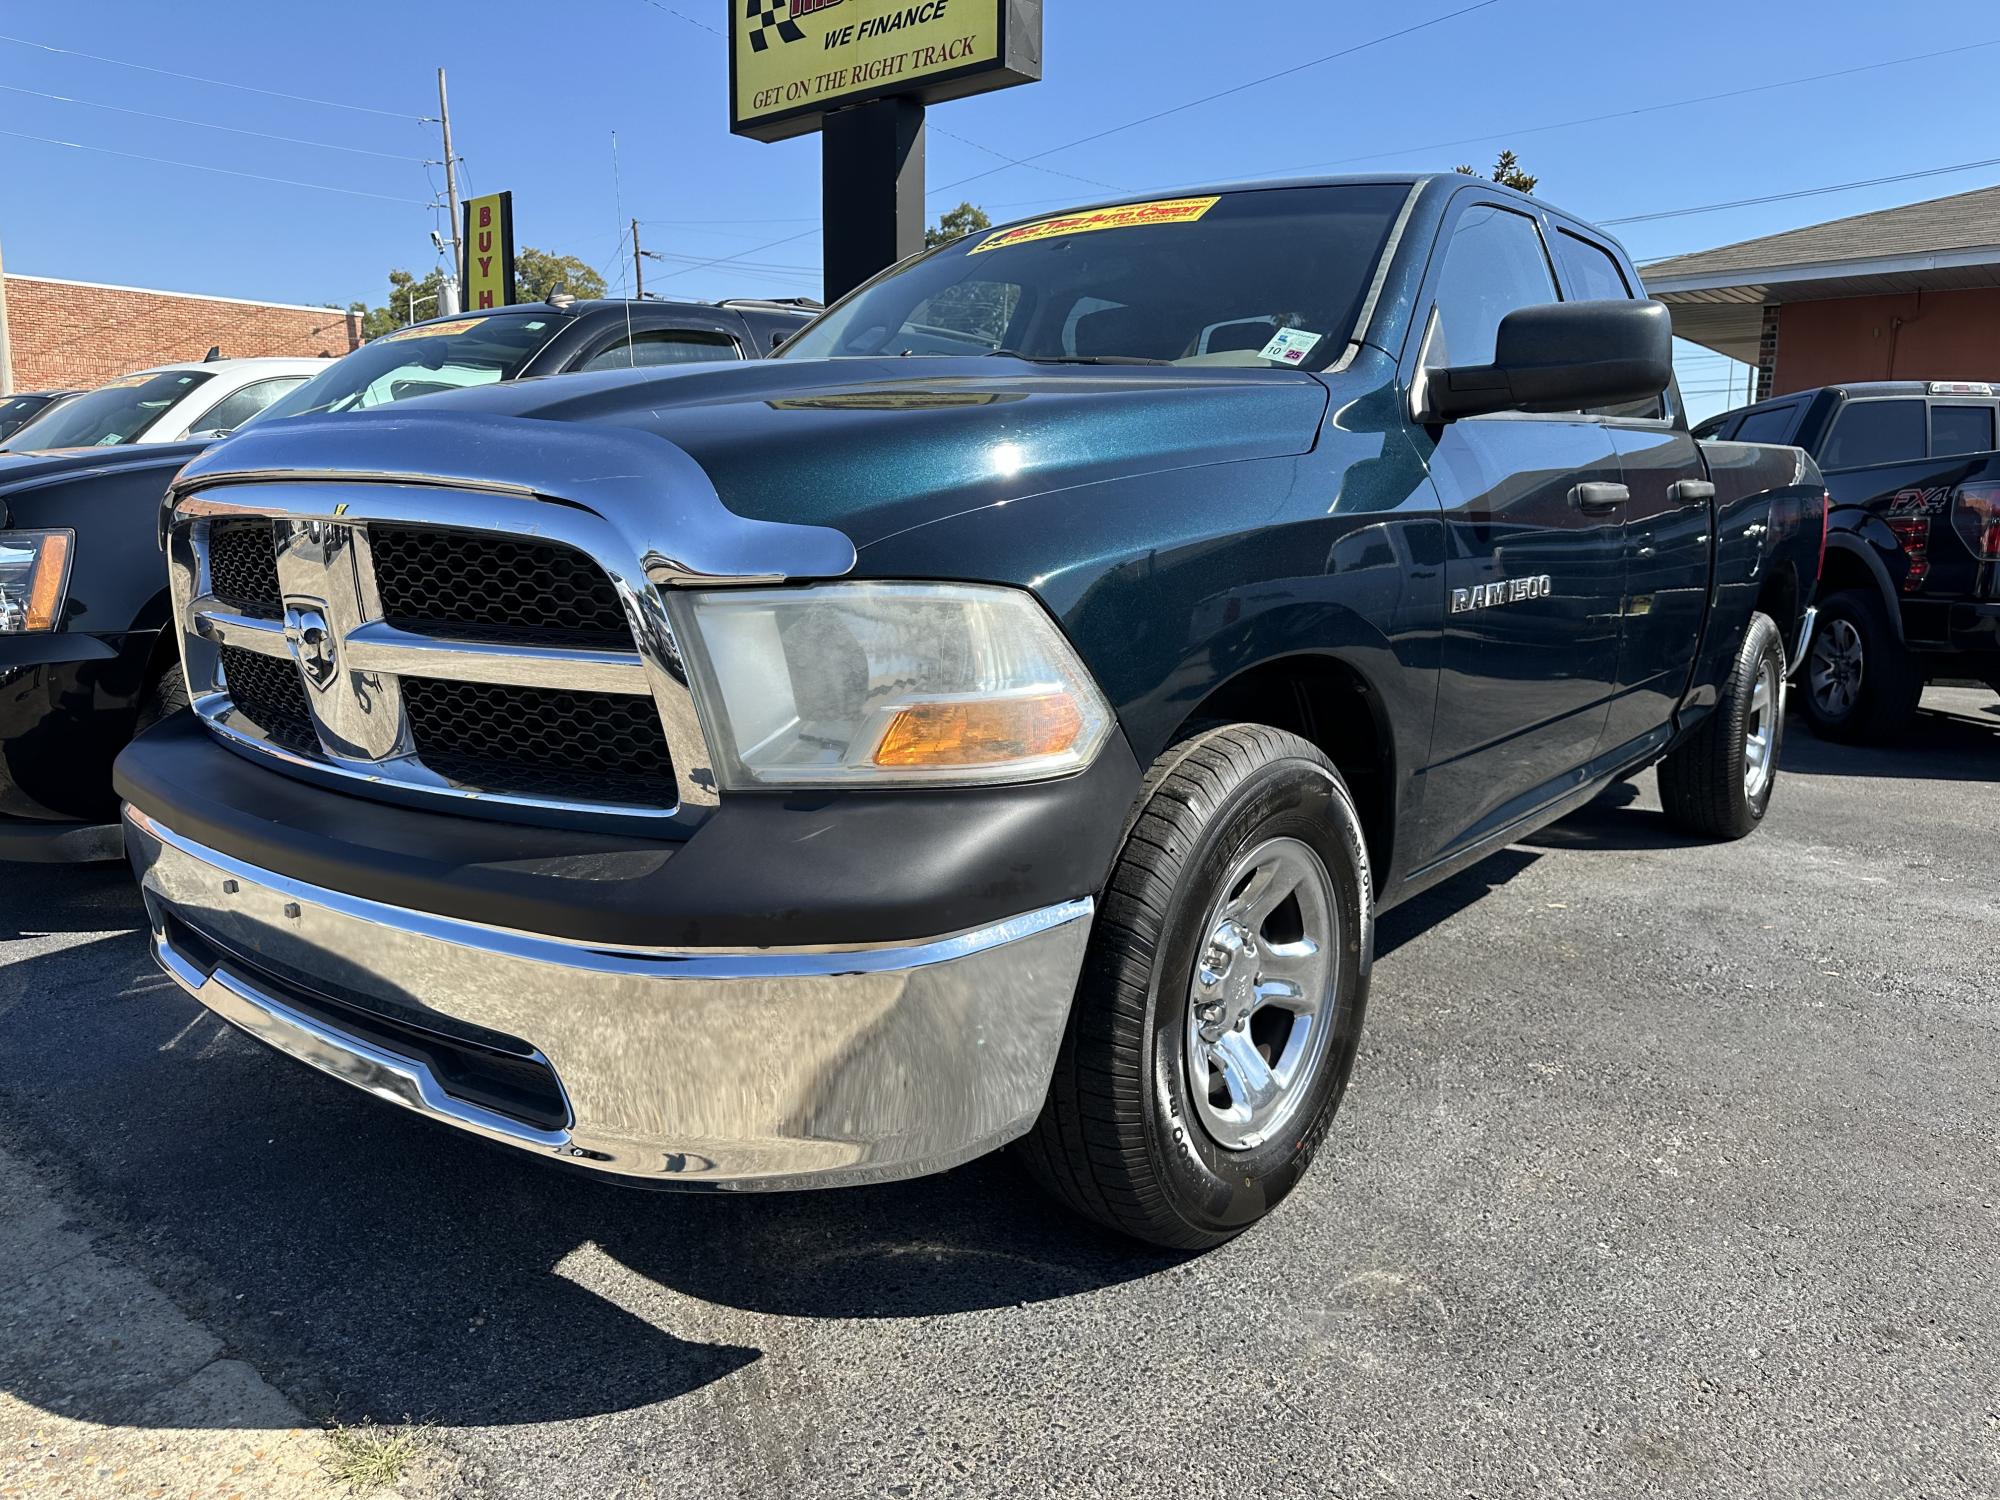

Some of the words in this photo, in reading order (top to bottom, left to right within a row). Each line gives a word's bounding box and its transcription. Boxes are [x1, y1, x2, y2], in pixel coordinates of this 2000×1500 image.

[824, 25, 855, 50] WE
[856, 0, 949, 41] FINANCE
[754, 86, 784, 109] GET
[786, 78, 812, 101] ON
[815, 68, 848, 93] THE
[851, 54, 907, 85] RIGHT
[911, 34, 977, 70] TRACK
[478, 206, 492, 278] BUY
[1267, 346, 1281, 355] 10
[1285, 350, 1300, 359] 25
[1890, 486, 1951, 509] FX4
[1449, 581, 1507, 613] RAM
[1507, 575, 1551, 602] 1500
